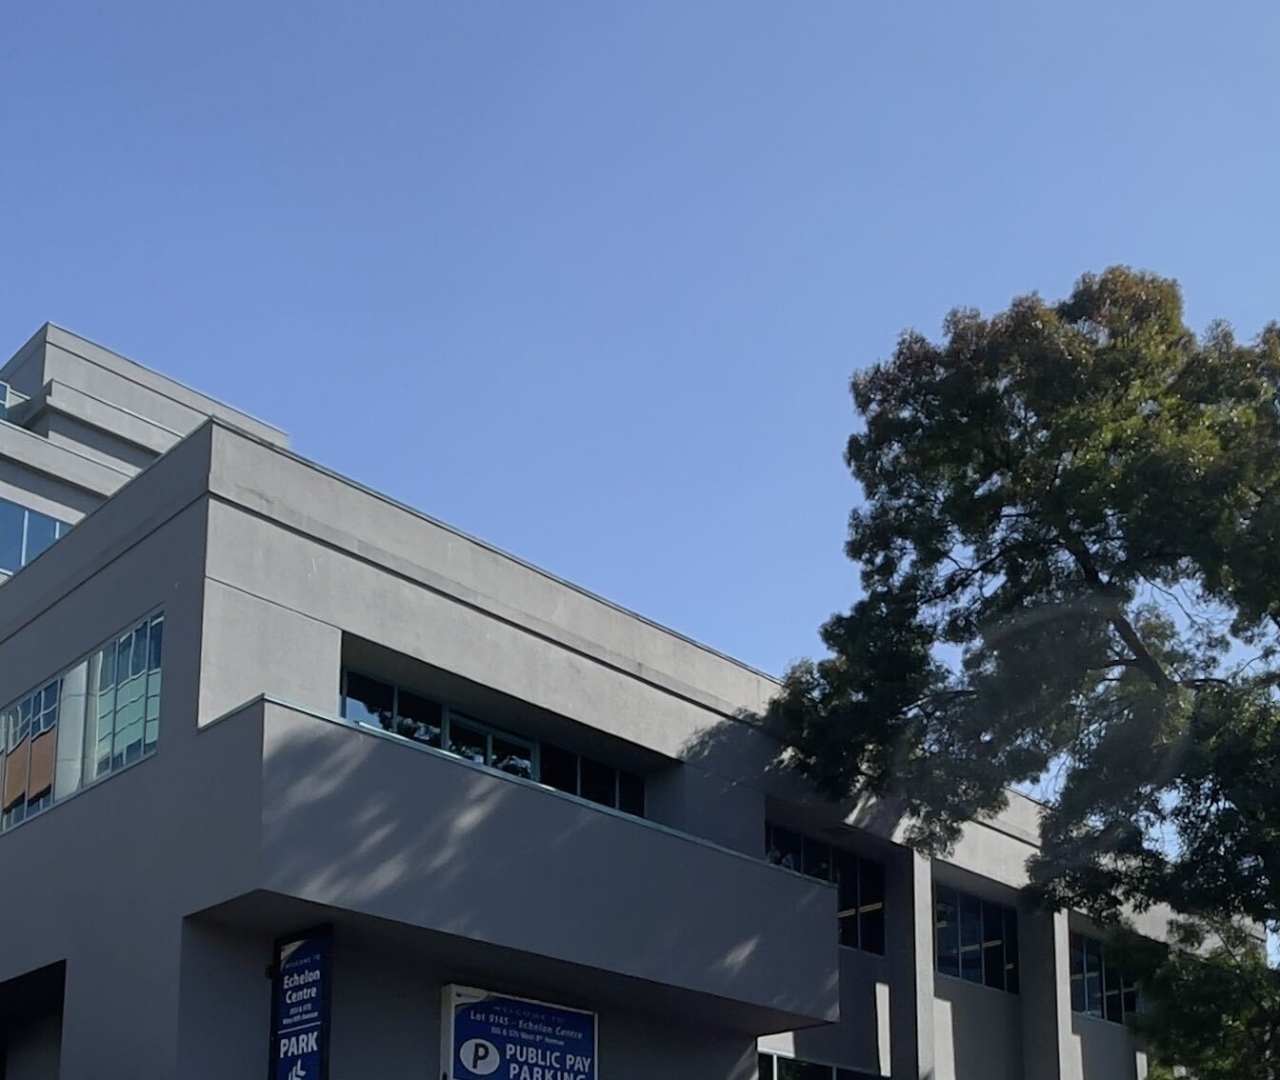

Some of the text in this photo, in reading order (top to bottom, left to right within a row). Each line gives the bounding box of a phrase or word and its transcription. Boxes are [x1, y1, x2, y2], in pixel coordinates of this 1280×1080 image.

[283, 969, 321, 989] Echelon
[285, 986, 317, 1004] Centre
[470, 1010, 486, 1021] Lot
[518, 1019, 554, 1034] Echelon
[555, 1026, 584, 1040] Centre
[279, 1031, 318, 1059] PARK
[472, 1042, 490, 1070] P
[505, 1042, 592, 1073] PUBLIC PAY
